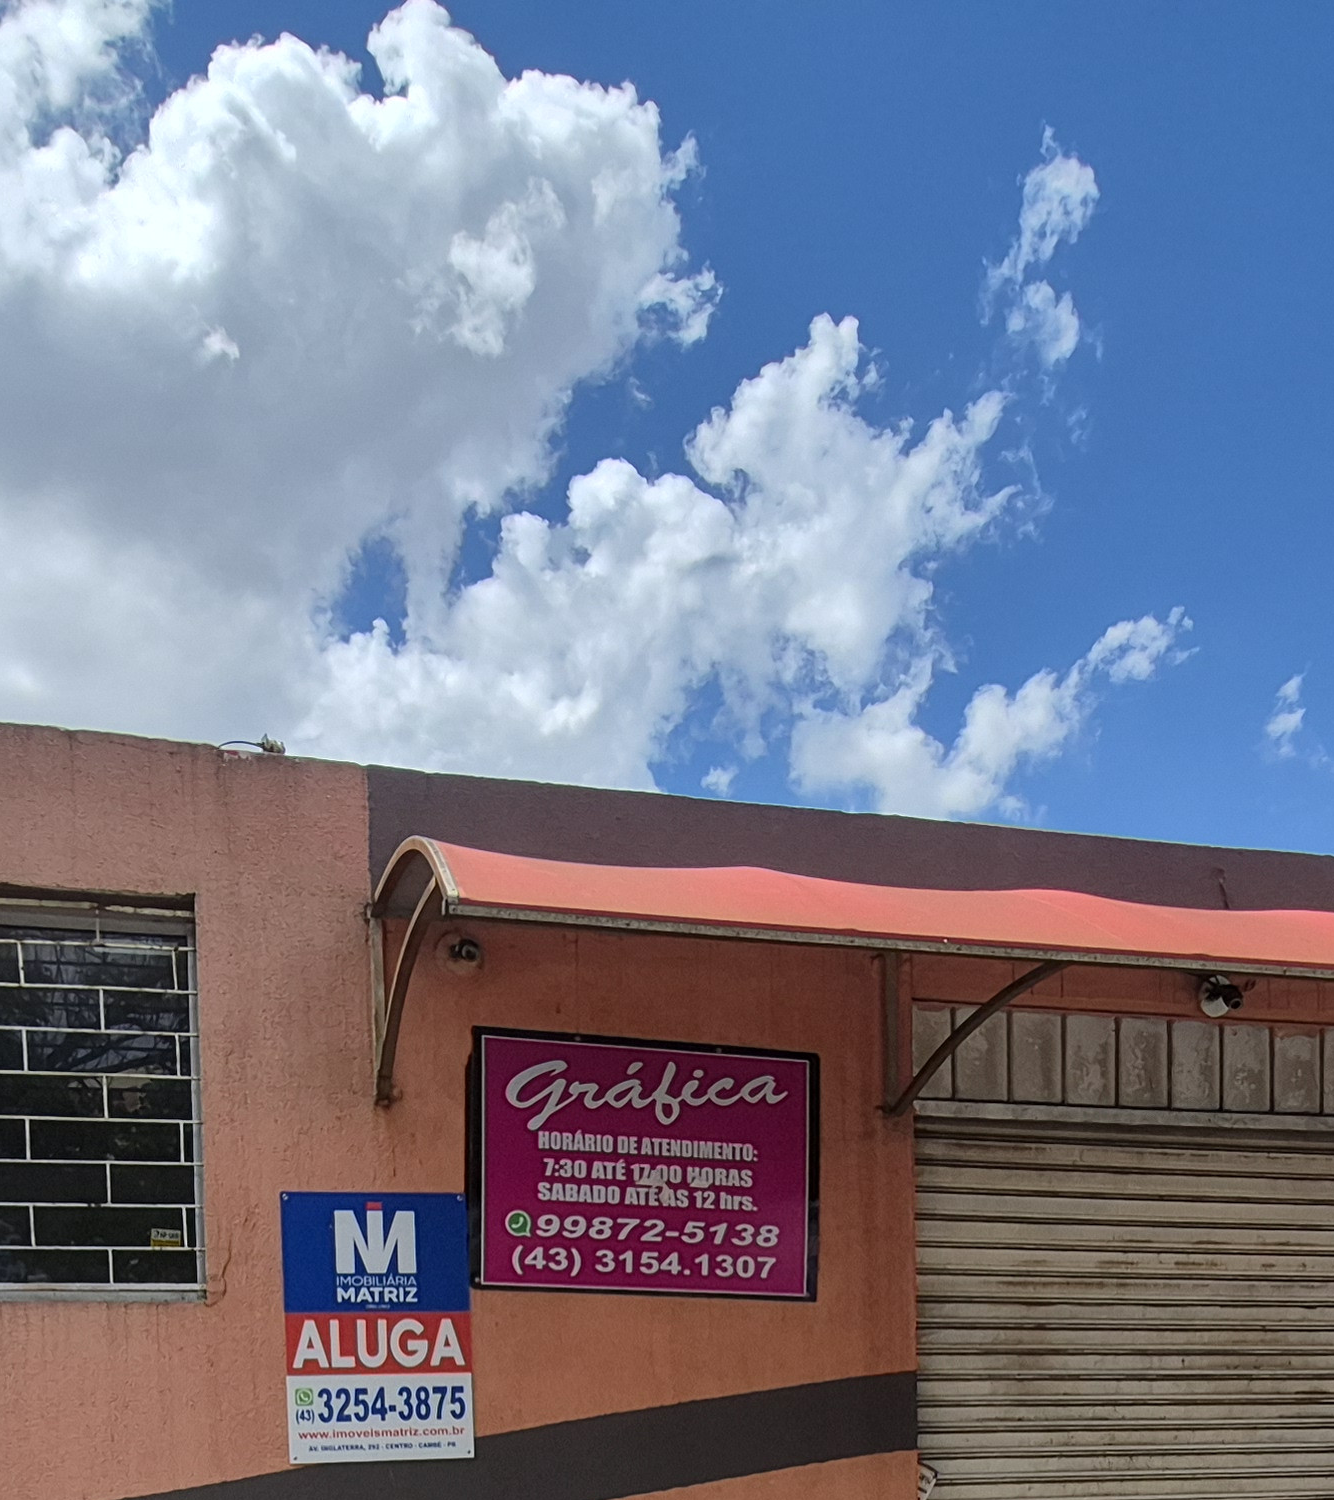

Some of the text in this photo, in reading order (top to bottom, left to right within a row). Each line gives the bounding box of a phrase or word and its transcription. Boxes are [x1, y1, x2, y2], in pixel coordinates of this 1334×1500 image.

[505, 1060, 789, 1131] Gráfica
[538, 1130, 759, 1162] HORÁRIO DE ATENDIMENTO:
[543, 1158, 587, 1179] 7:30
[591, 1159, 627, 1181] ATÉ
[687, 1166, 753, 1188] HORAS
[537, 1182, 621, 1205] SABADO
[693, 1191, 716, 1209] 12
[720, 1192, 759, 1212] hrs.
[535, 1214, 781, 1248] 99872-5138
[511, 1245, 777, 1279] (43) 3154.1307
[336, 1273, 417, 1287] IMOBILIÁRIA
[336, 1287, 418, 1303] MATRIZ
[292, 1318, 466, 1369] ALUGA
[295, 1386, 466, 1425] (43) 3254-3875
[298, 1426, 465, 1440] www.imoveismatriz.com.br
[385, 1442, 414, 1450] CENTRO
